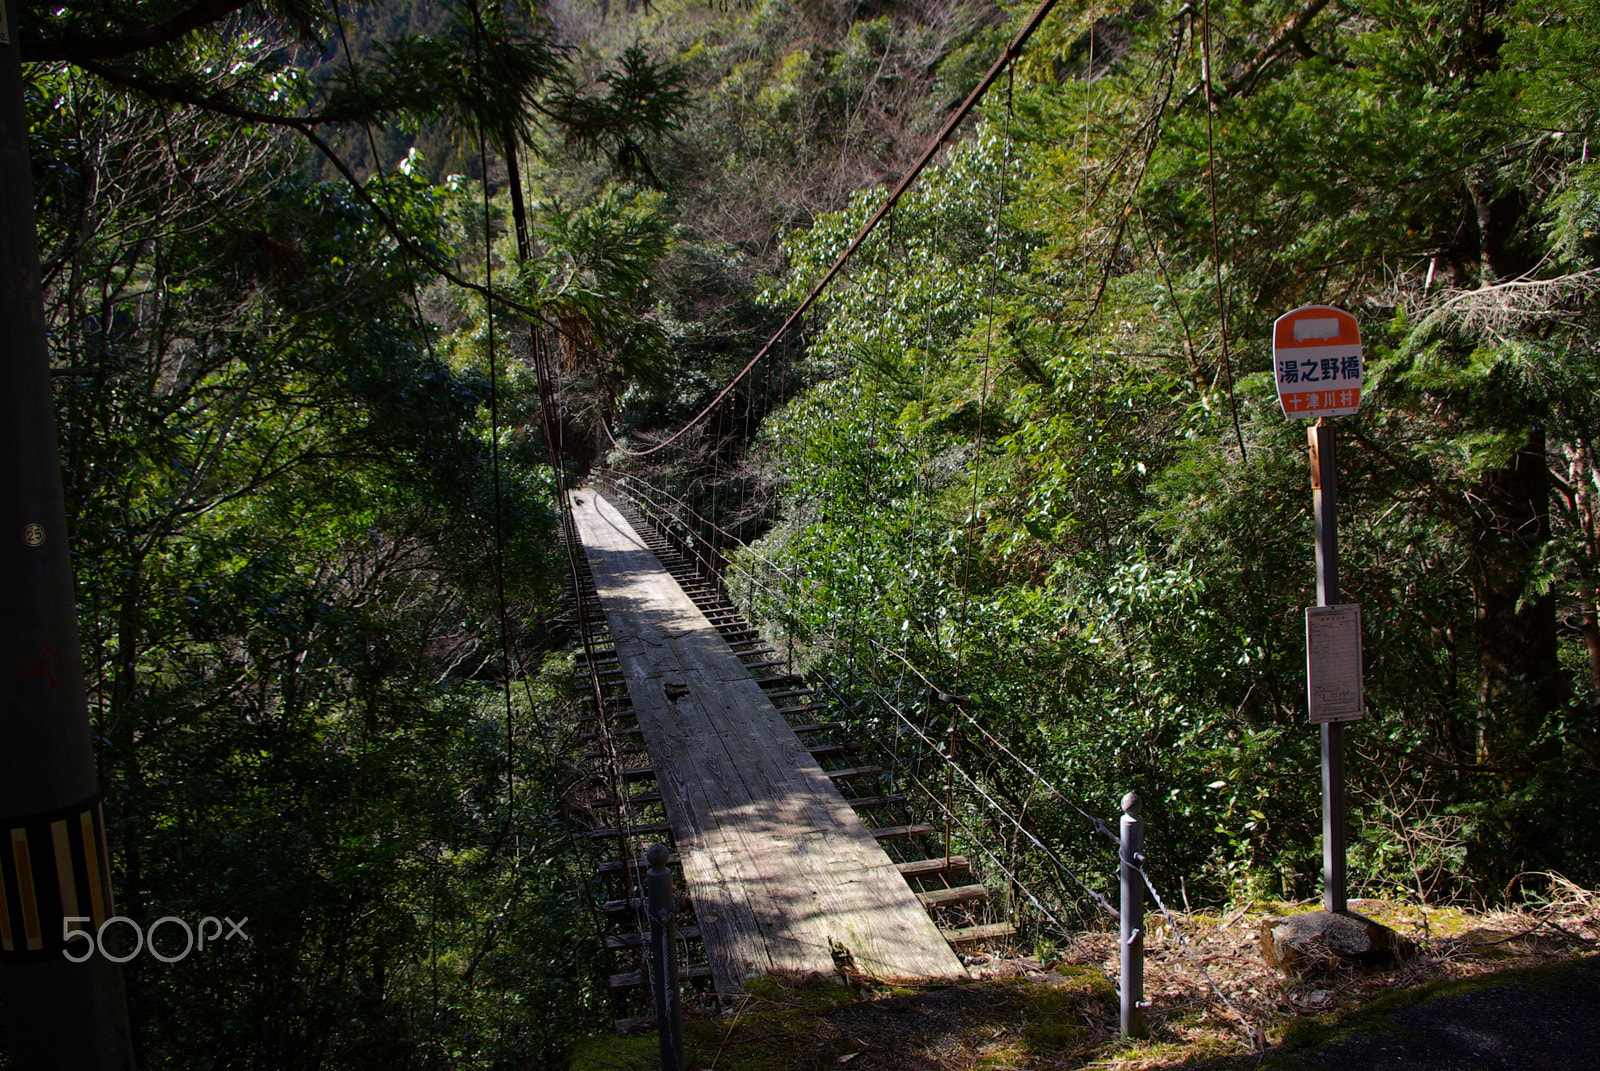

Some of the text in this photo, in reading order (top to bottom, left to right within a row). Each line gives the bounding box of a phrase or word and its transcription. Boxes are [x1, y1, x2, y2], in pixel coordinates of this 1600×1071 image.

[1279, 355, 1360, 384] 湯之野橋
[1288, 390, 1353, 411] 十津川村
[26, 528, 42, 541] 25
